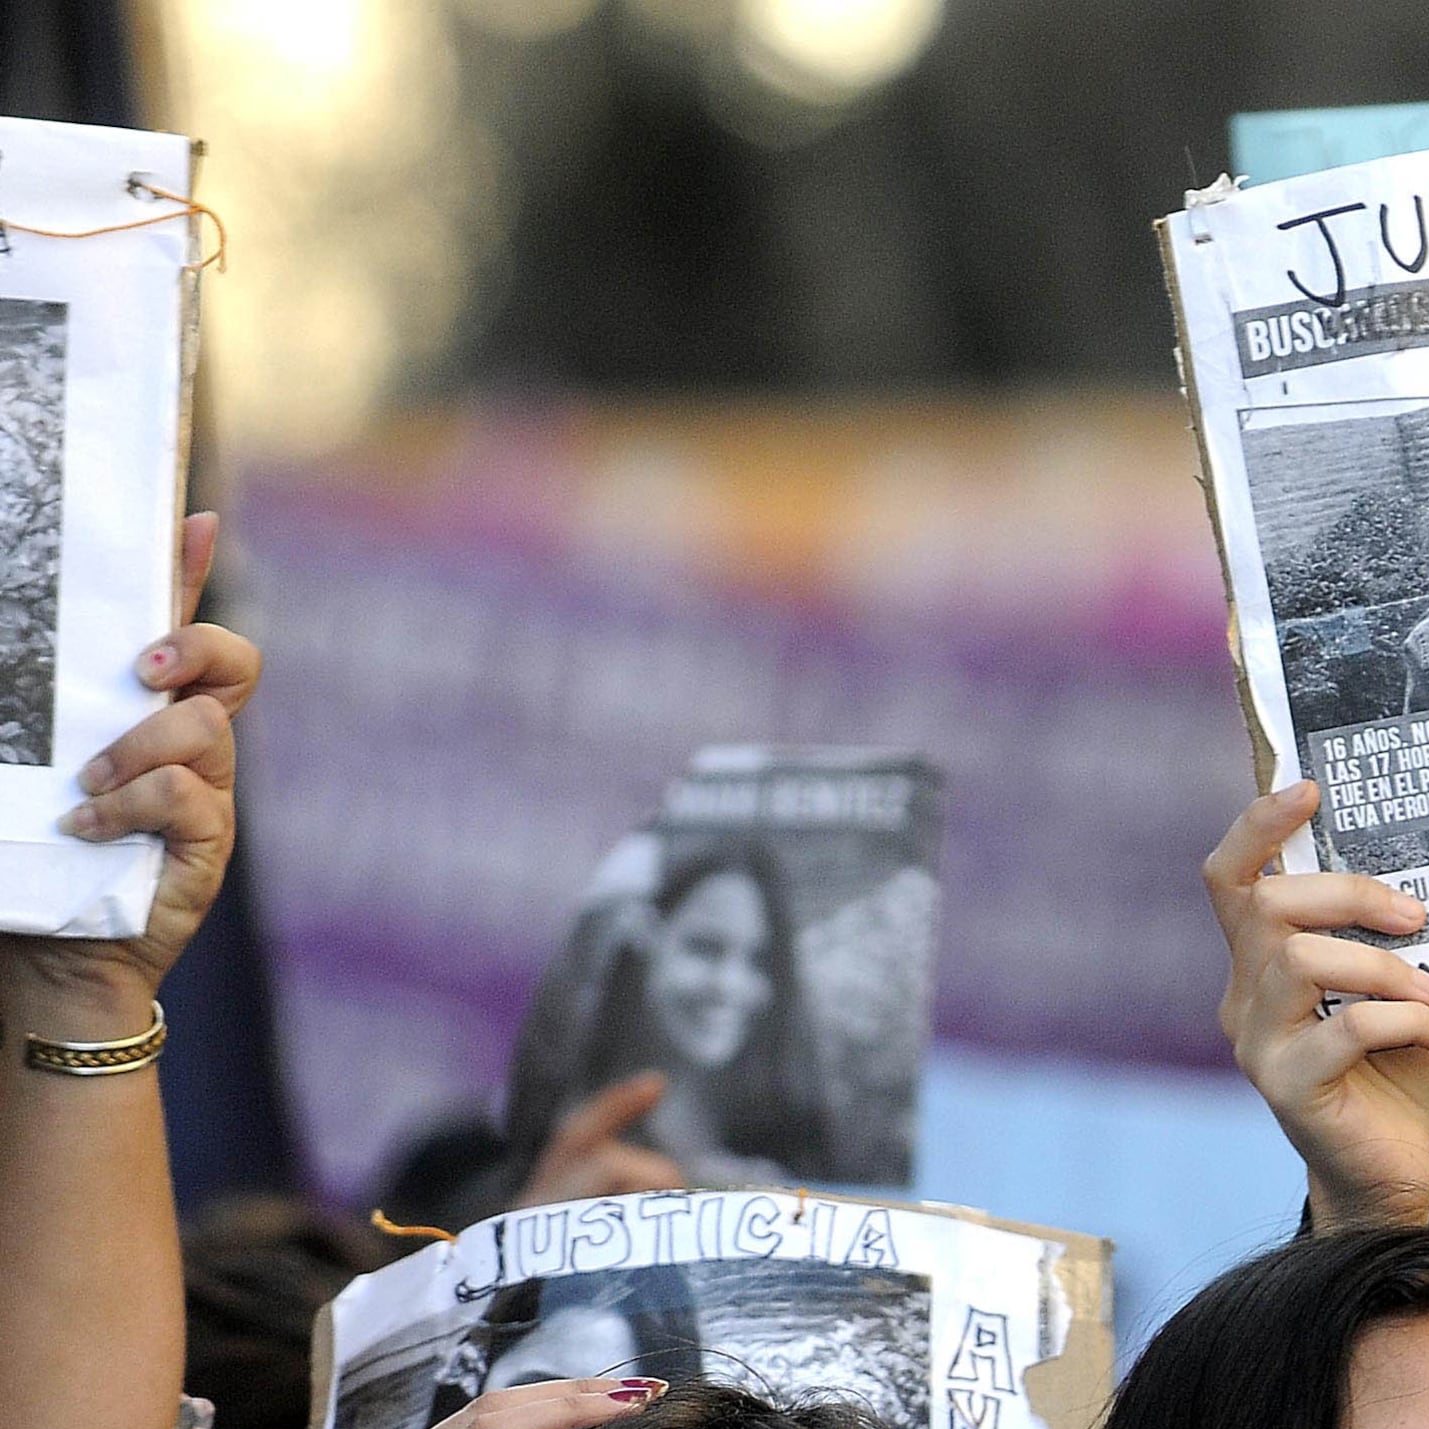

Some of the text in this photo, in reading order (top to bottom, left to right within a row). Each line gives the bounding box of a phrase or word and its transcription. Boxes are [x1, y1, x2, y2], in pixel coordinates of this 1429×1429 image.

[1323, 738, 1346, 762] 16
[1353, 726, 1408, 757] AÑOS.
[1325, 758, 1362, 785] LAS
[1369, 753, 1390, 777] 17
[1329, 781, 1366, 809] FUE
[1367, 777, 1393, 800] EN
[1395, 770, 1418, 794] EL
[1334, 802, 1380, 832] (EVA
